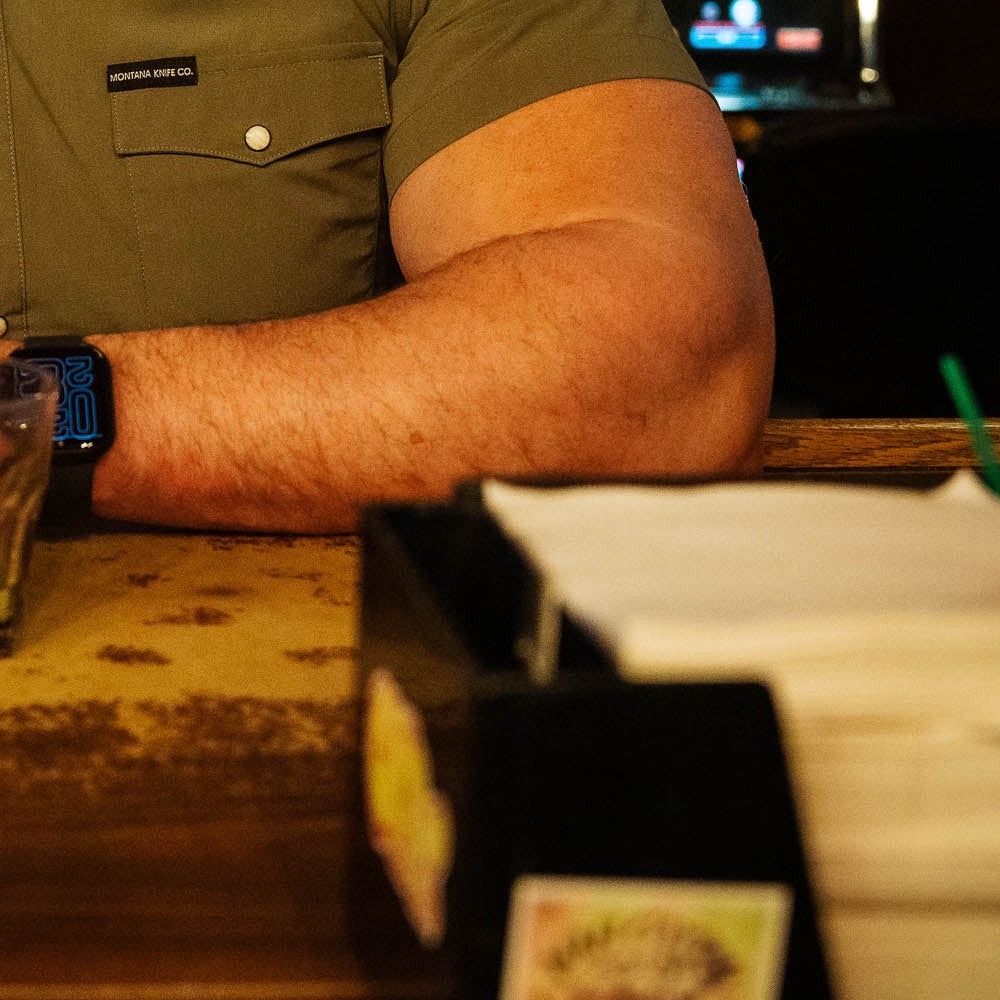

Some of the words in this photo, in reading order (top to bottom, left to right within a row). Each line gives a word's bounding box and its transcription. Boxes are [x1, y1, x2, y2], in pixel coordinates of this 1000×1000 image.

[110, 69, 152, 82] MONTANA
[153, 67, 176, 78] KNIFE
[177, 67, 194, 77] CO.
